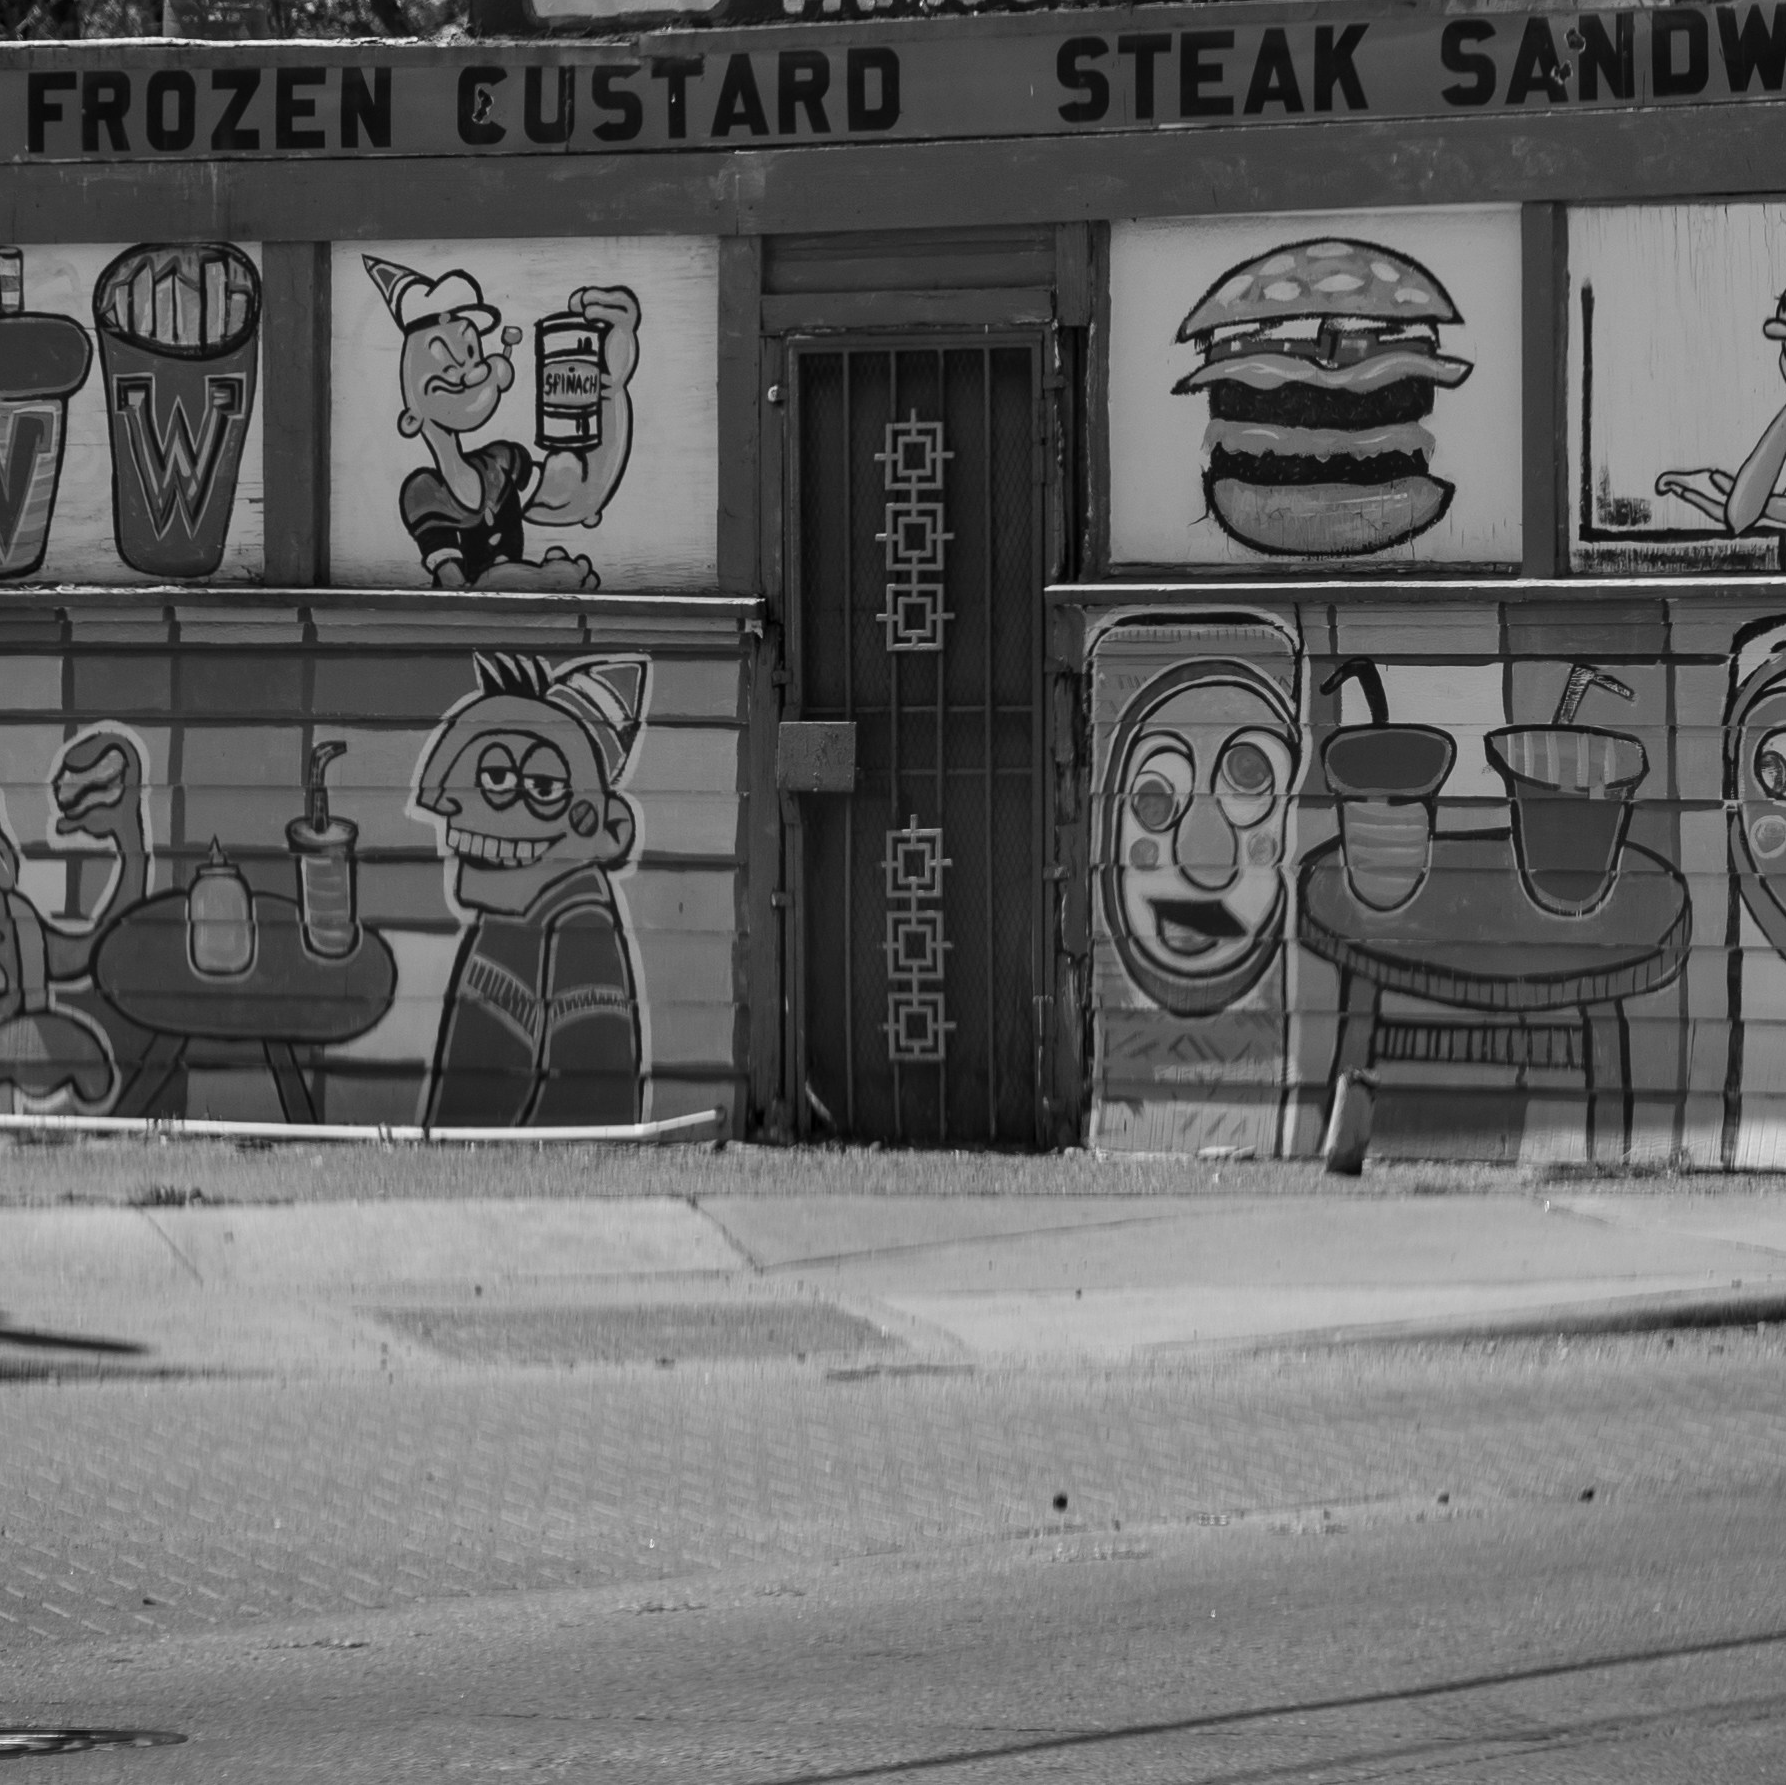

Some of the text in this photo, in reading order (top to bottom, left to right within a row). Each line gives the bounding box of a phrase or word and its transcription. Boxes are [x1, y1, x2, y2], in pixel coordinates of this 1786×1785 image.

[24, 65, 393, 154] FROZEN
[455, 46, 901, 147] CUSTARD
[1055, 22, 1371, 123] STEAK
[543, 372, 598, 397] SPINACH
